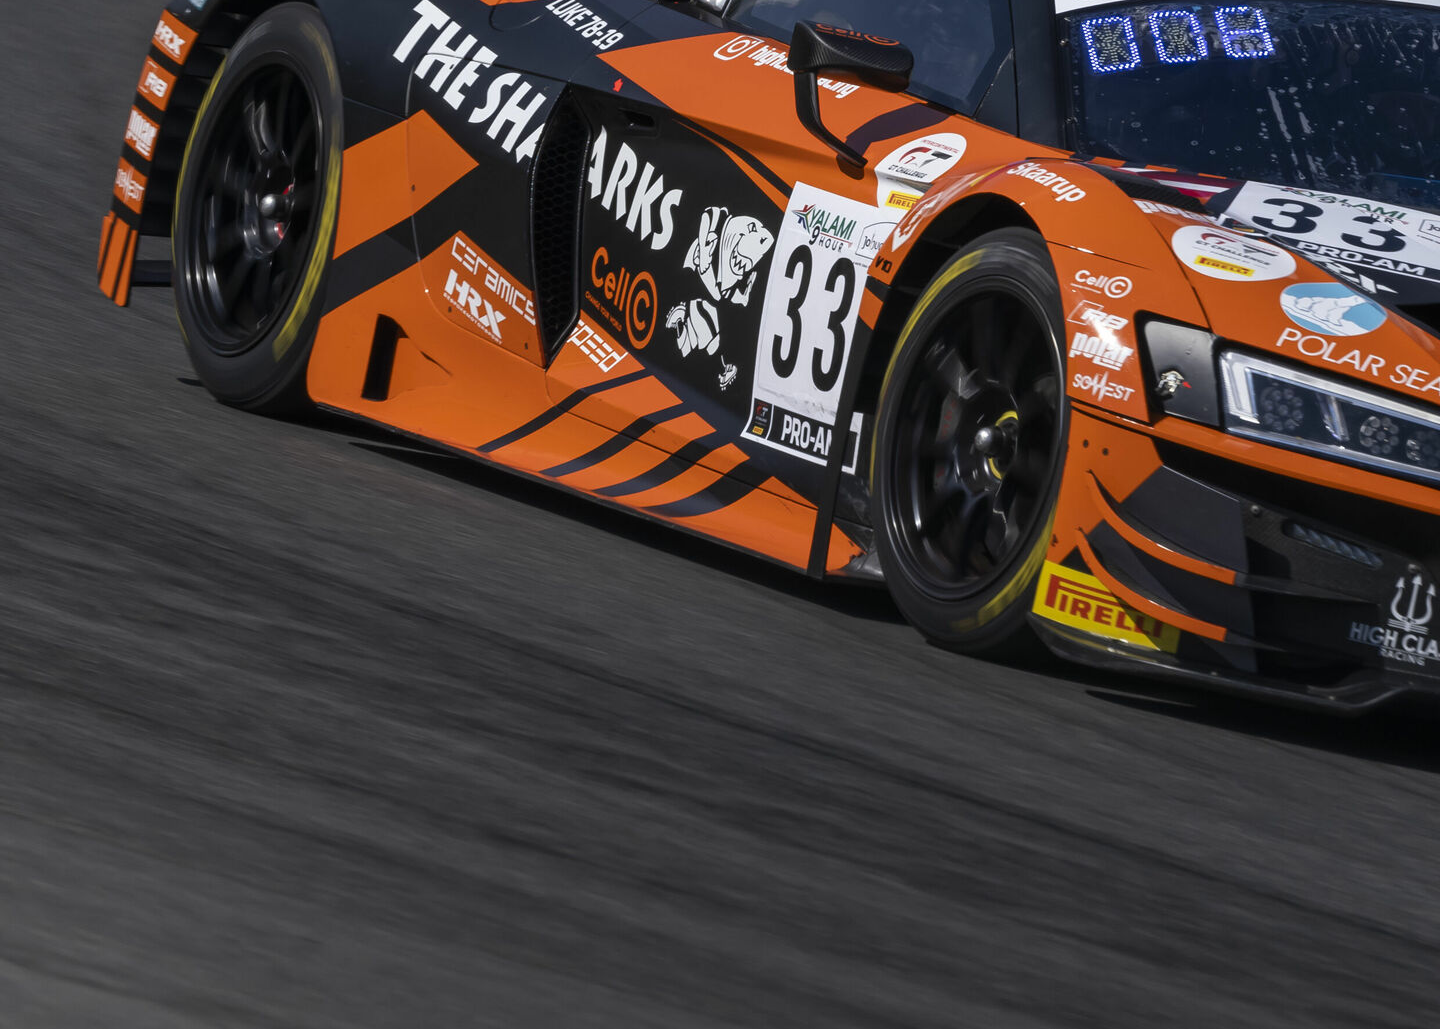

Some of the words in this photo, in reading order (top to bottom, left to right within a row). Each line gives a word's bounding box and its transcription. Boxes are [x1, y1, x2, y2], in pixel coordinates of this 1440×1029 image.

[575, 12, 624, 51] 78-19
[1006, 162, 1087, 202] Skaarup
[809, 225, 821, 246] 9
[819, 235, 844, 253] HOUR
[1251, 197, 1407, 253] 33
[875, 255, 893, 274] V10
[1296, 240, 1426, 276] PRO-AM
[444, 268, 507, 340] HRX
[771, 243, 856, 393] 33
[1275, 326, 1386, 377] POLAR
[1044, 573, 1164, 640] PIRELLI
[1348, 621, 1399, 649] HIGH
